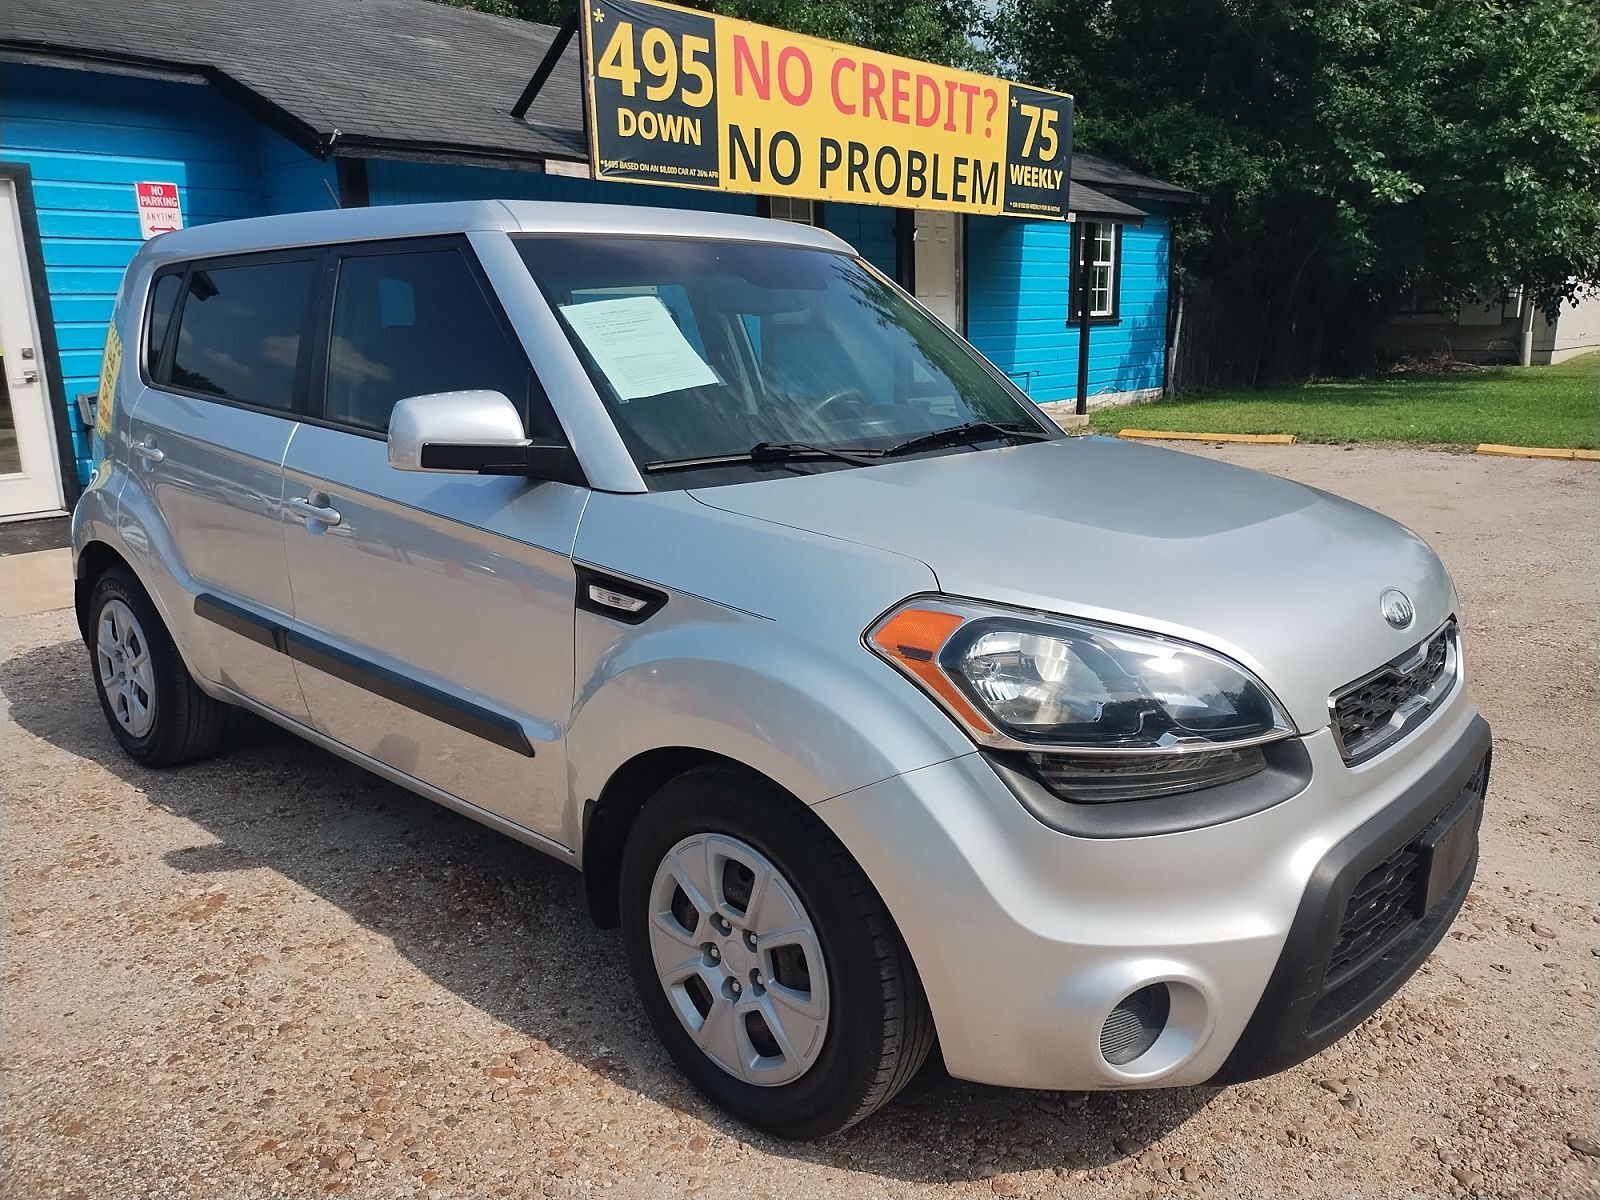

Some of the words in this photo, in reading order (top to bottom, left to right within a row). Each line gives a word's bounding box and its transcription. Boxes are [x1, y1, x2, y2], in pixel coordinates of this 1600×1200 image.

[733, 34, 813, 107] NO
[830, 57, 999, 139] CREDIT?
[617, 107, 702, 146] DOWN
[619, 161, 639, 171] BASED
[640, 163, 650, 172] ON
[650, 165, 660, 173] AN
[678, 167, 689, 176] CAR
[689, 168, 697, 177] AT
[728, 123, 802, 186] NO
[819, 136, 1000, 206] PROBLEM
[1009, 163, 1064, 191] WEEKLY
[140, 195, 178, 207] PARKING
[150, 185, 164, 196] NO
[146, 211, 177, 222] ANYTIME
